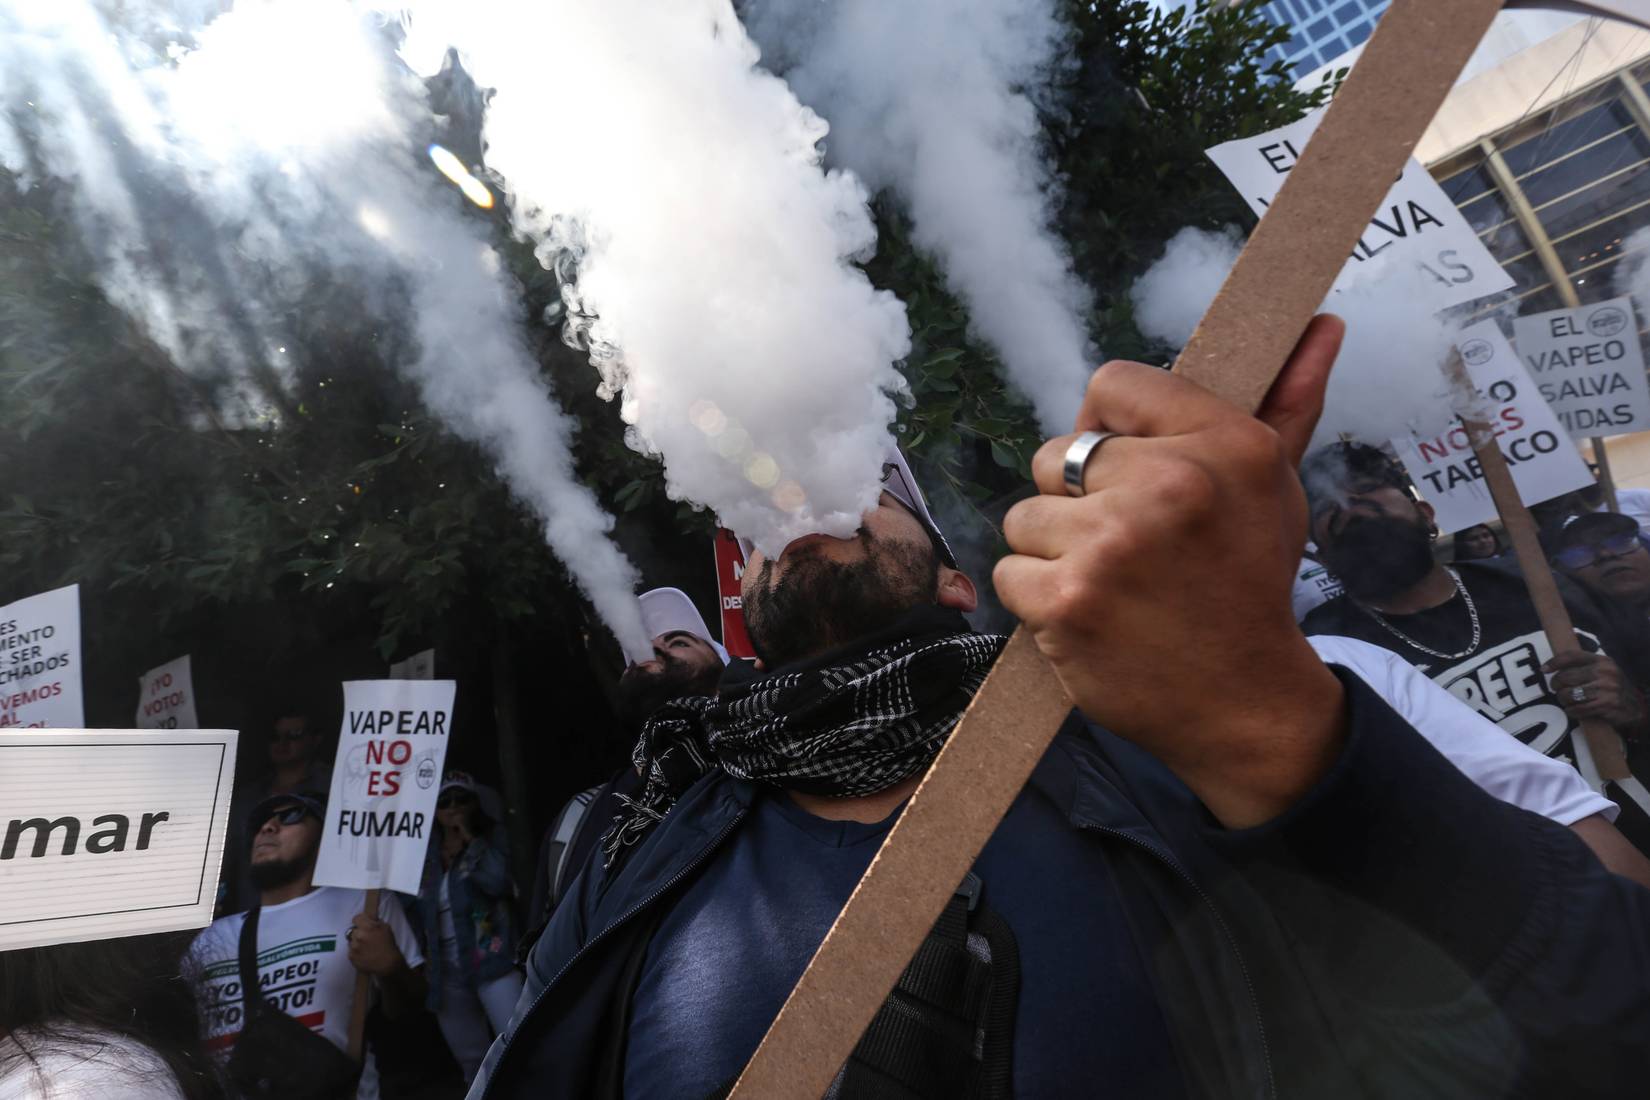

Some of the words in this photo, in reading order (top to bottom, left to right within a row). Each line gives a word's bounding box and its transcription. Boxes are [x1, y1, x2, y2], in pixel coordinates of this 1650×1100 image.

[1550, 315, 1584, 338] EL
[1527, 340, 1625, 372] VAPEO
[1538, 372, 1632, 403] SALVA
[1418, 427, 1471, 464] NO
[10, 645, 42, 664] SER
[1447, 647, 1546, 722] REE
[349, 710, 446, 736] VAPEAR
[366, 739, 412, 766] NO
[367, 770, 401, 797] ES
[0, 811, 170, 860] mar
[337, 809, 425, 839] FUMAR
[258, 959, 320, 989] APEO!
